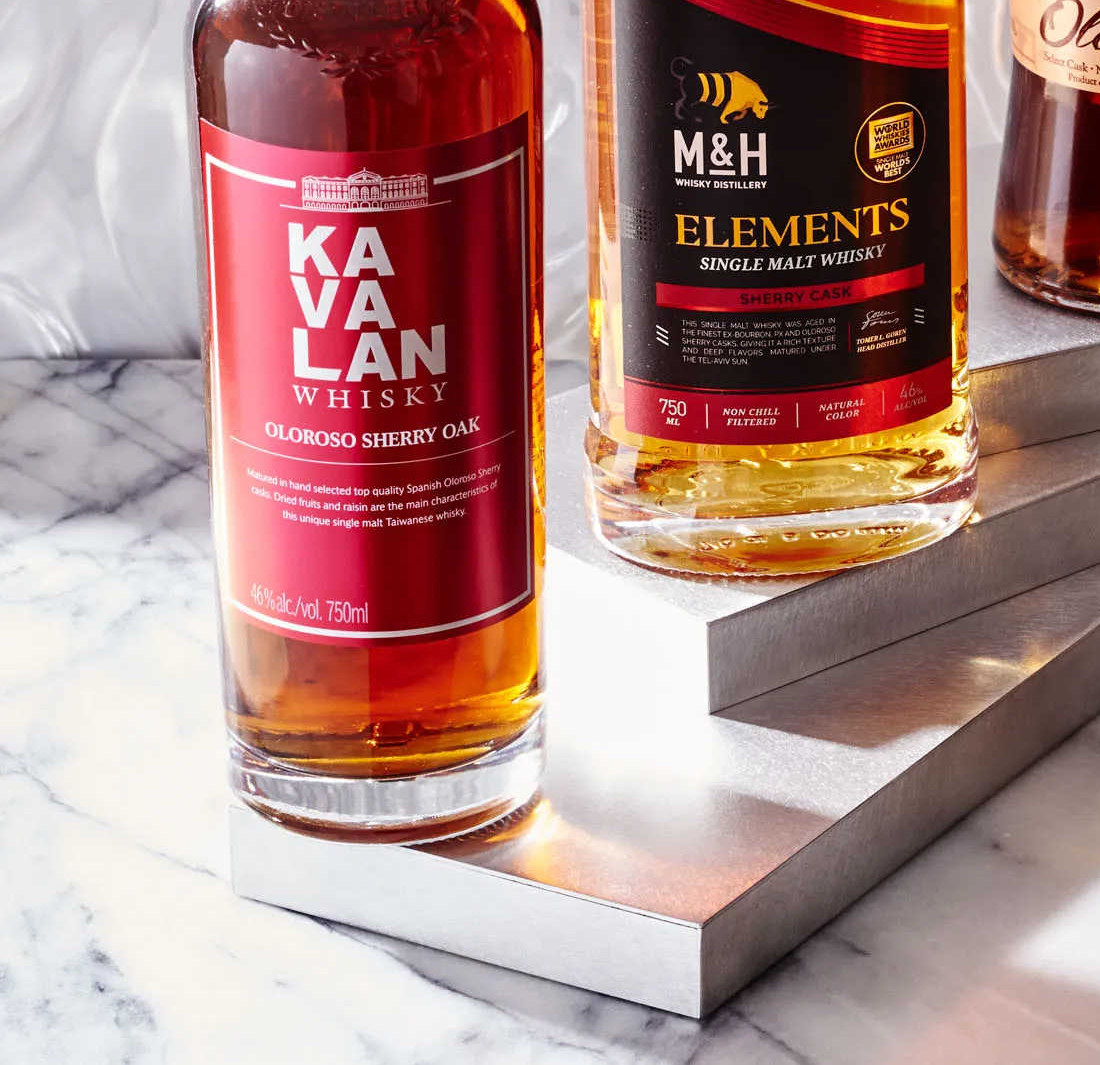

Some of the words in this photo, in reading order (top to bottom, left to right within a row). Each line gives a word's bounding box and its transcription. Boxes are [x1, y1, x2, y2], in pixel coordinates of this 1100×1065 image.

[1043, 50, 1066, 68] Select
[1067, 59, 1088, 73] Cask
[1068, 73, 1097, 86] Product
[874, 120, 910, 136] WORLD
[874, 128, 910, 142] WHISKIES
[874, 135, 910, 150] AWARDS
[674, 129, 768, 176] M&H
[884, 167, 903, 178] BEST
[675, 178, 711, 188] WHISKY
[713, 180, 767, 190] DISTILLERY
[674, 197, 910, 248] ELEMENTS
[699, 256, 764, 272] SINGLE
[768, 254, 817, 271] MALT
[820, 243, 887, 267] WHISKY
[740, 291, 805, 305] SHERRY
[810, 286, 852, 302] CASK
[682, 319, 697, 327] THIS
[701, 321, 727, 329] SINGLE
[753, 321, 782, 329] WHISKY
[785, 320, 801, 328] WAS
[805, 318, 825, 326] AGED
[682, 329, 696, 337] THE
[697, 330, 722, 338] FINEST
[802, 326, 836, 336] OLOROSO
[856, 335, 879, 345] TOMER
[885, 328, 907, 339] GOREN
[682, 337, 711, 346] SHERRY
[783, 338, 801, 346] RICH
[803, 335, 836, 345] TEXTURE
[857, 344, 875, 353] HEAD
[876, 336, 907, 349] DISTILLER
[770, 347, 806, 355] MATURED
[811, 344, 837, 353] UNDER
[683, 355, 696, 363] THE
[292, 382, 448, 409] WHISKY
[659, 398, 687, 416] 750
[722, 408, 746, 416] NON
[749, 408, 780, 416] CHILL
[819, 398, 865, 412] NATURAL
[666, 417, 680, 426] ML
[726, 418, 777, 426] FILTERED
[825, 409, 860, 421] COLOR
[265, 421, 356, 448] OLOROSO
[362, 427, 438, 449] SHERRY
[442, 416, 480, 439] OAK
[247, 467, 278, 485] Matured
[289, 480, 311, 492] hand
[313, 485, 352, 496] selected
[353, 487, 370, 497] top
[372, 486, 405, 497] quality
[406, 480, 442, 496] Spanish
[443, 473, 477, 487] Oloroso
[478, 463, 501, 478] Sherry
[251, 485, 272, 500] casks.
[273, 492, 297, 505] Dried
[298, 498, 321, 509] fruits
[323, 502, 341, 511] and
[343, 503, 368, 512] raisin
[387, 502, 403, 511] the
[405, 499, 429, 510] main
[431, 483, 489, 506] characteristics
[282, 510, 298, 521] this
[299, 514, 331, 526] unique
[332, 517, 360, 529] single
[362, 518, 383, 528] malt
[385, 514, 434, 527] Taiwanese
[436, 507, 467, 521] whisky.
[326, 599, 369, 624] 750ml
